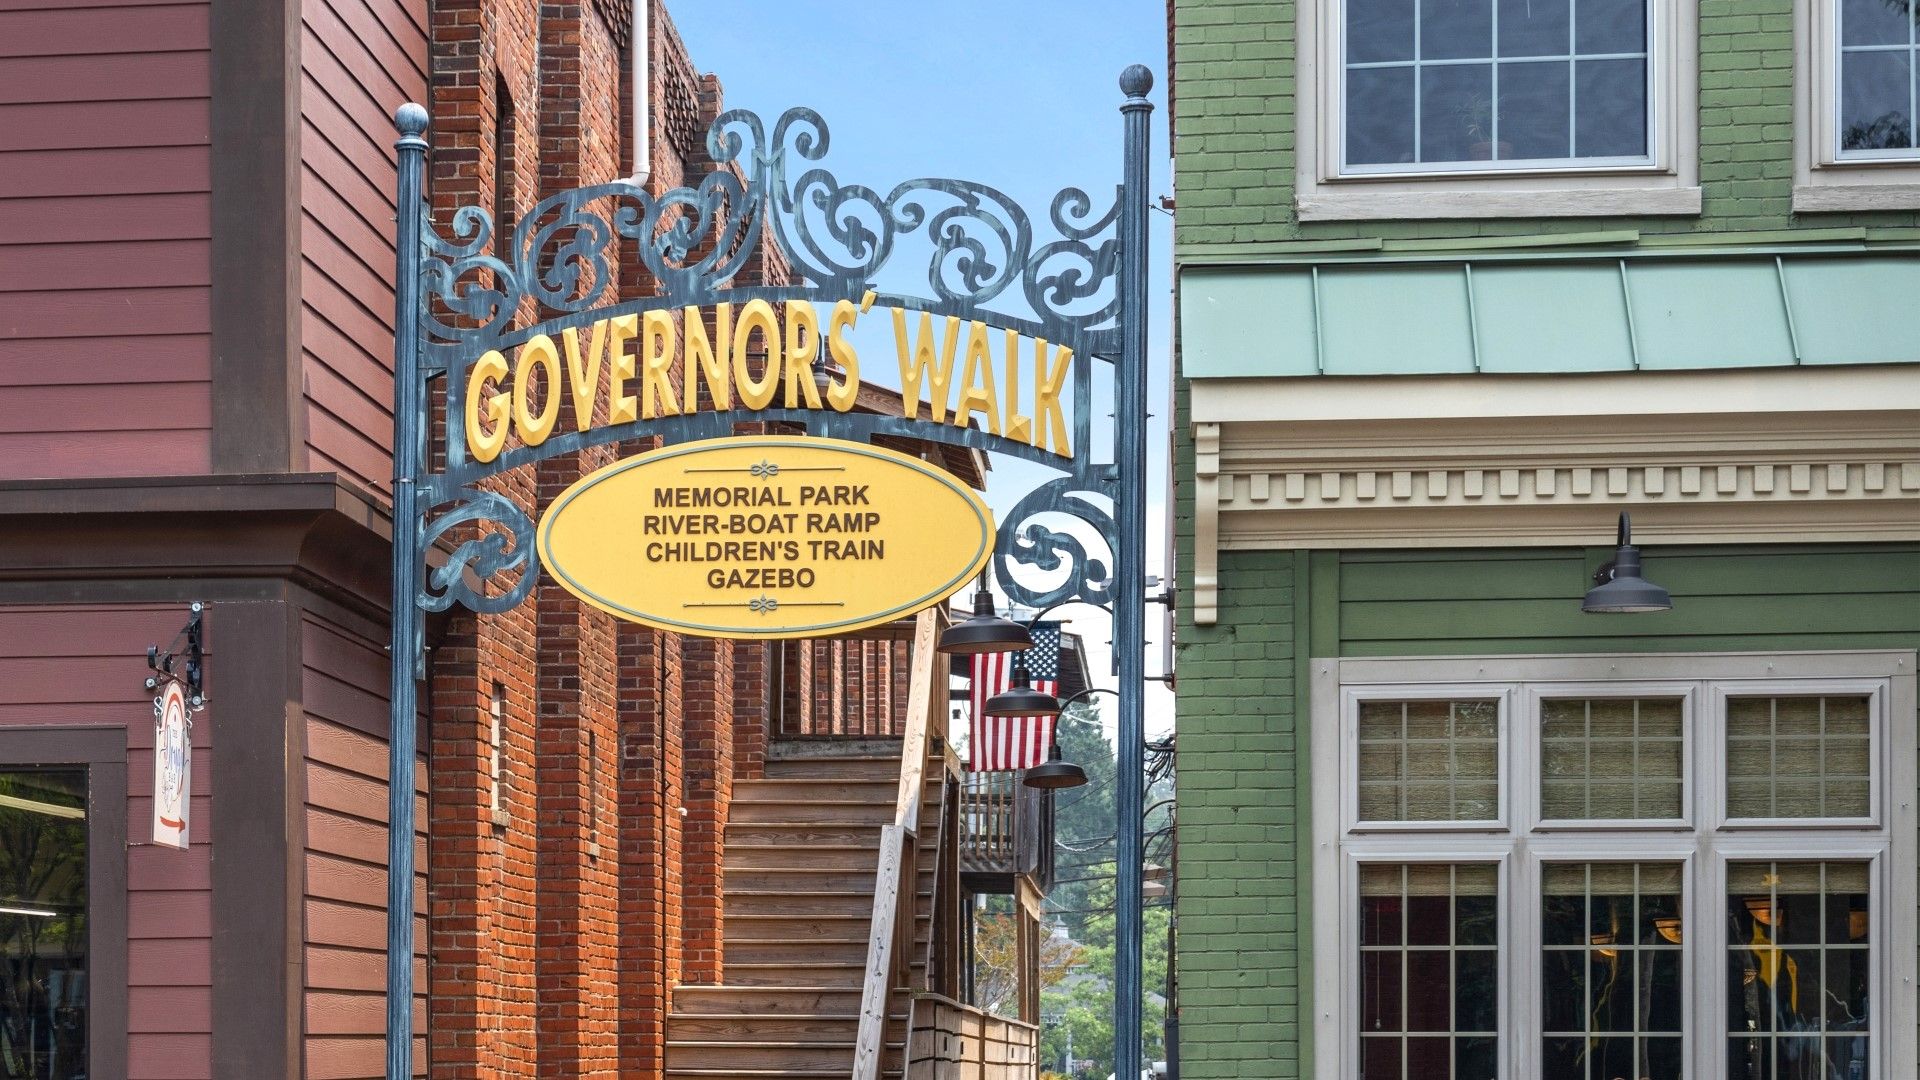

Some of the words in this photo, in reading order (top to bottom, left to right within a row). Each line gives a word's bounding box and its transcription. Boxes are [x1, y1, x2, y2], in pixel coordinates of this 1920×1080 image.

[465, 290, 877, 463] GOVERNORS'
[891, 307, 1075, 459] WALK
[654, 487, 792, 508] MEMORIAL
[800, 485, 870, 506] PARK
[644, 513, 799, 535] RIVER-BOAT
[807, 512, 881, 533] RAMP
[646, 540, 800, 562] CHILDREN'S
[807, 540, 884, 560] TRAIN
[707, 567, 816, 588] GAZEBO
